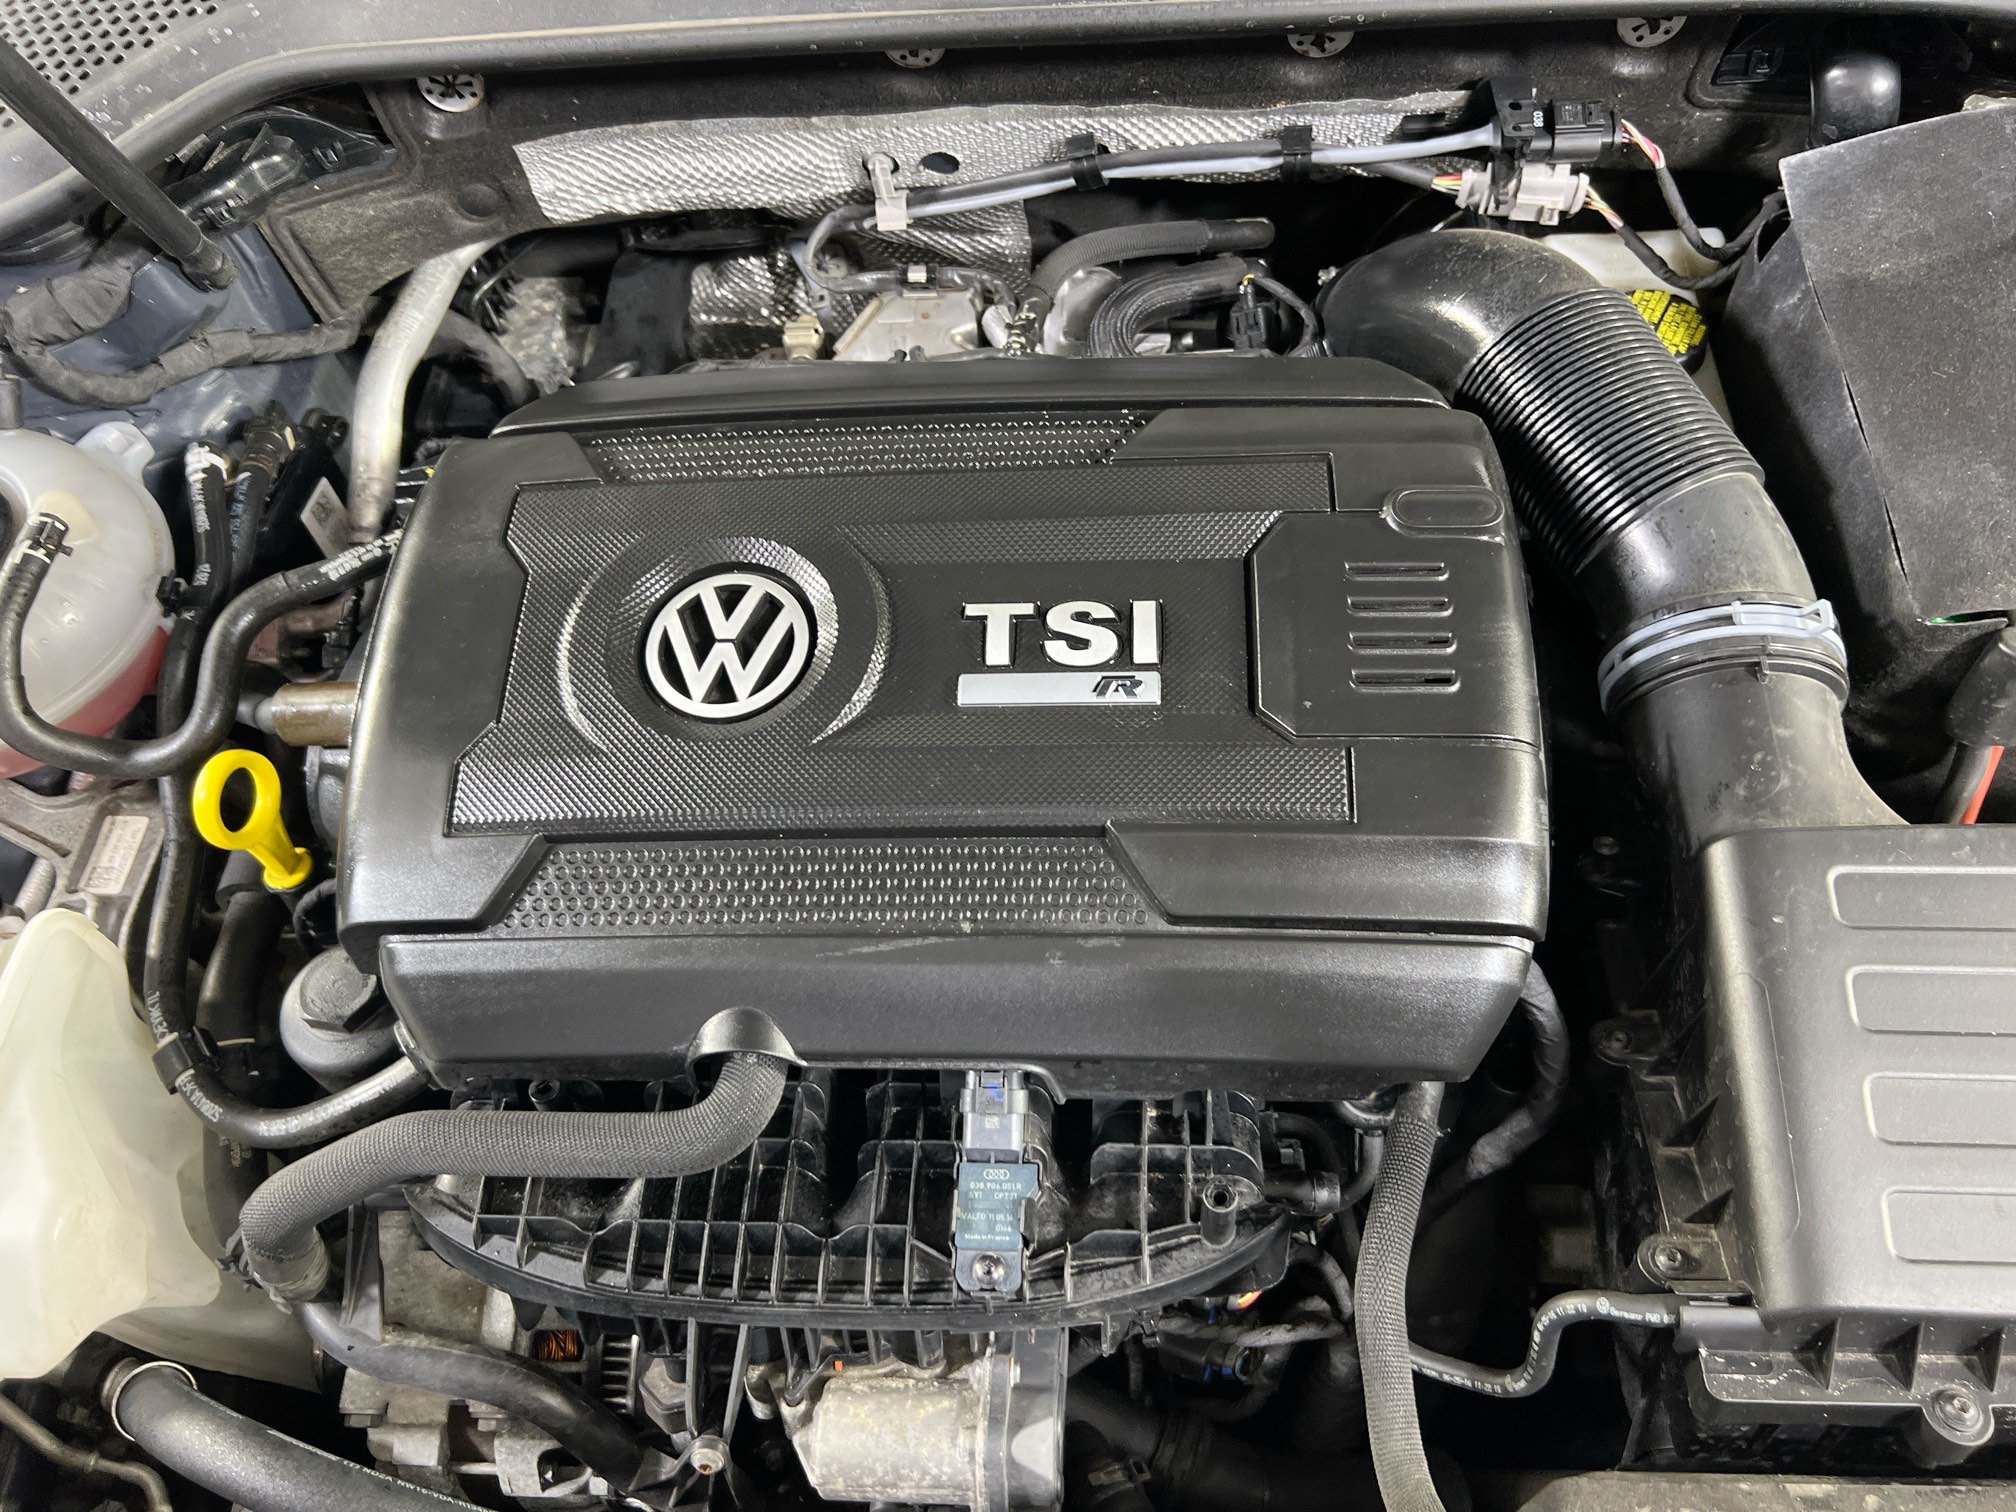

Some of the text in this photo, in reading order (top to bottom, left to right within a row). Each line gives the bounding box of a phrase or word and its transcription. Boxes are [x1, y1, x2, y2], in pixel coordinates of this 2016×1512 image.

[645, 573, 810, 718] VW
[963, 600, 1162, 667] TSI
[1092, 675, 1146, 701] R
